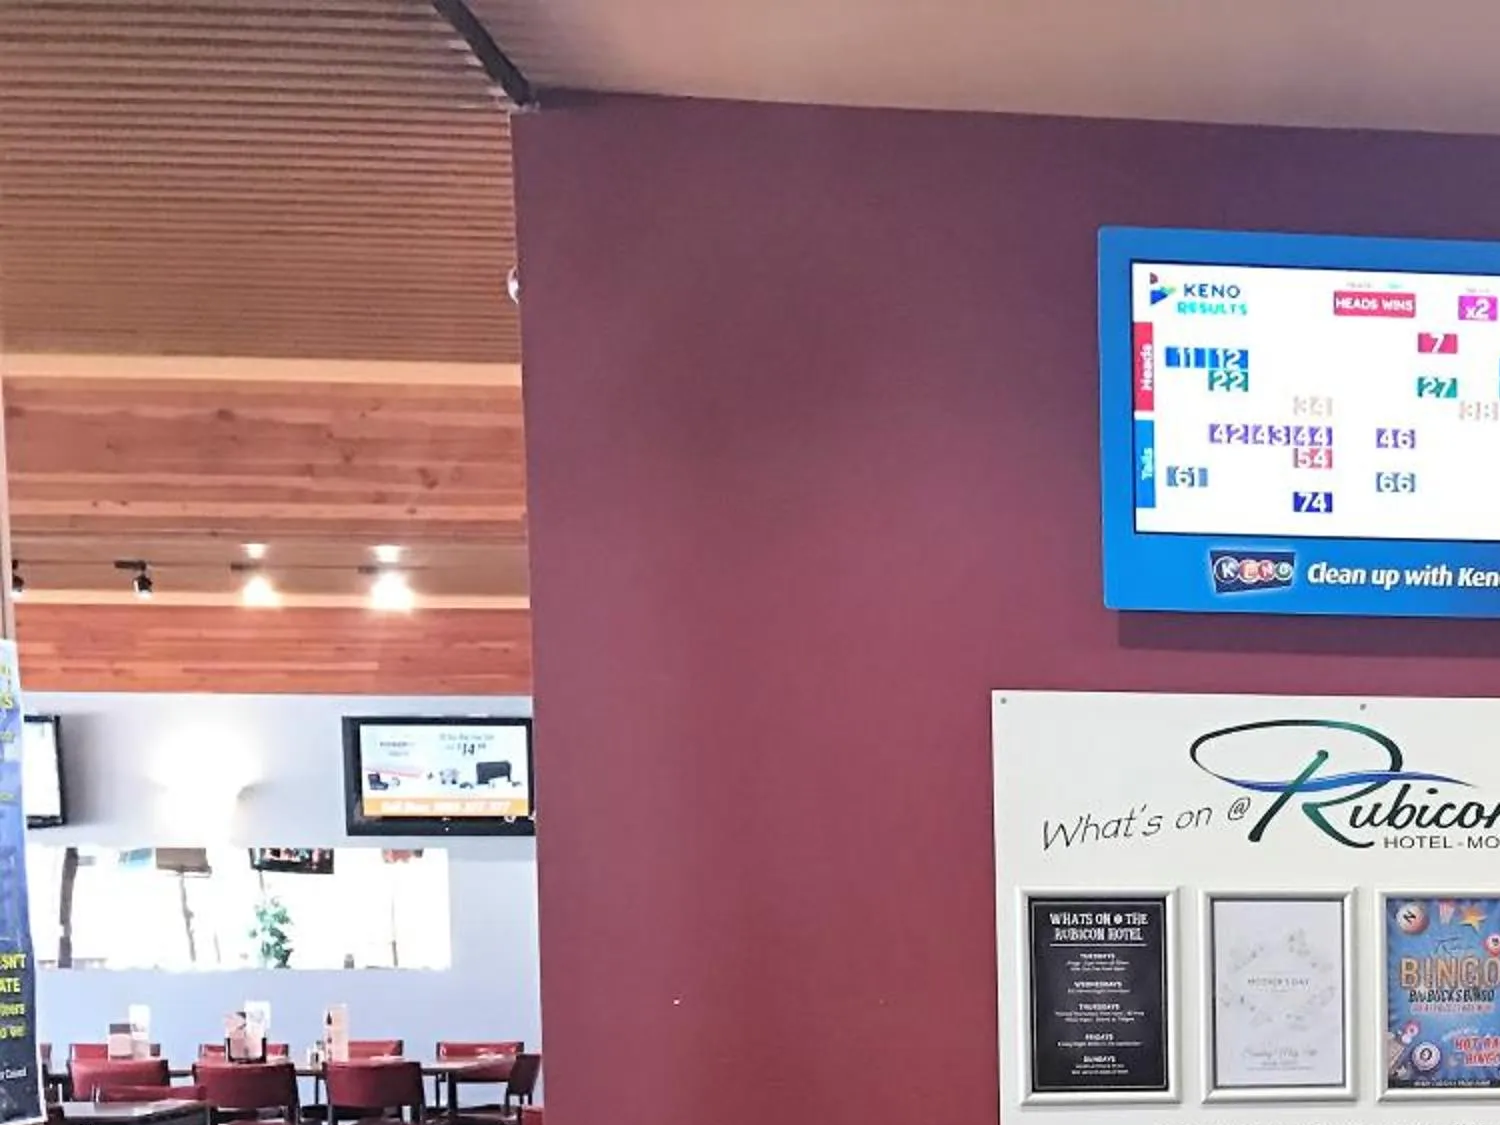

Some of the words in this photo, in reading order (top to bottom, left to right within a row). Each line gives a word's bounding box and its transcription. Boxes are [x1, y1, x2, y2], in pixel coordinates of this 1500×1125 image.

[1184, 283, 1241, 298] KENO
[1177, 301, 1248, 316] RESULTS
[1335, 299, 1378, 311] HEADS
[1382, 300, 1414, 312] WINS
[1216, 349, 1241, 370] 12
[1213, 371, 1245, 390] 22
[1424, 378, 1451, 397] 27
[1213, 425, 1246, 444] 42
[1254, 426, 1287, 445] 43
[1295, 426, 1327, 446] 44
[1379, 429, 1411, 448] 46
[1297, 449, 1328, 468] 54
[1175, 466, 1200, 487] 61
[1379, 473, 1412, 492] 66
[1299, 492, 1327, 512] 74
[1216, 557, 1293, 581] KENO
[1307, 562, 1365, 584] Clean
[1371, 567, 1400, 590] up
[1404, 563, 1453, 586] with
[1041, 805, 1163, 851] What's
[1175, 807, 1213, 830] on
[1227, 796, 1252, 821] @
[1124, 912, 1149, 925] THE
